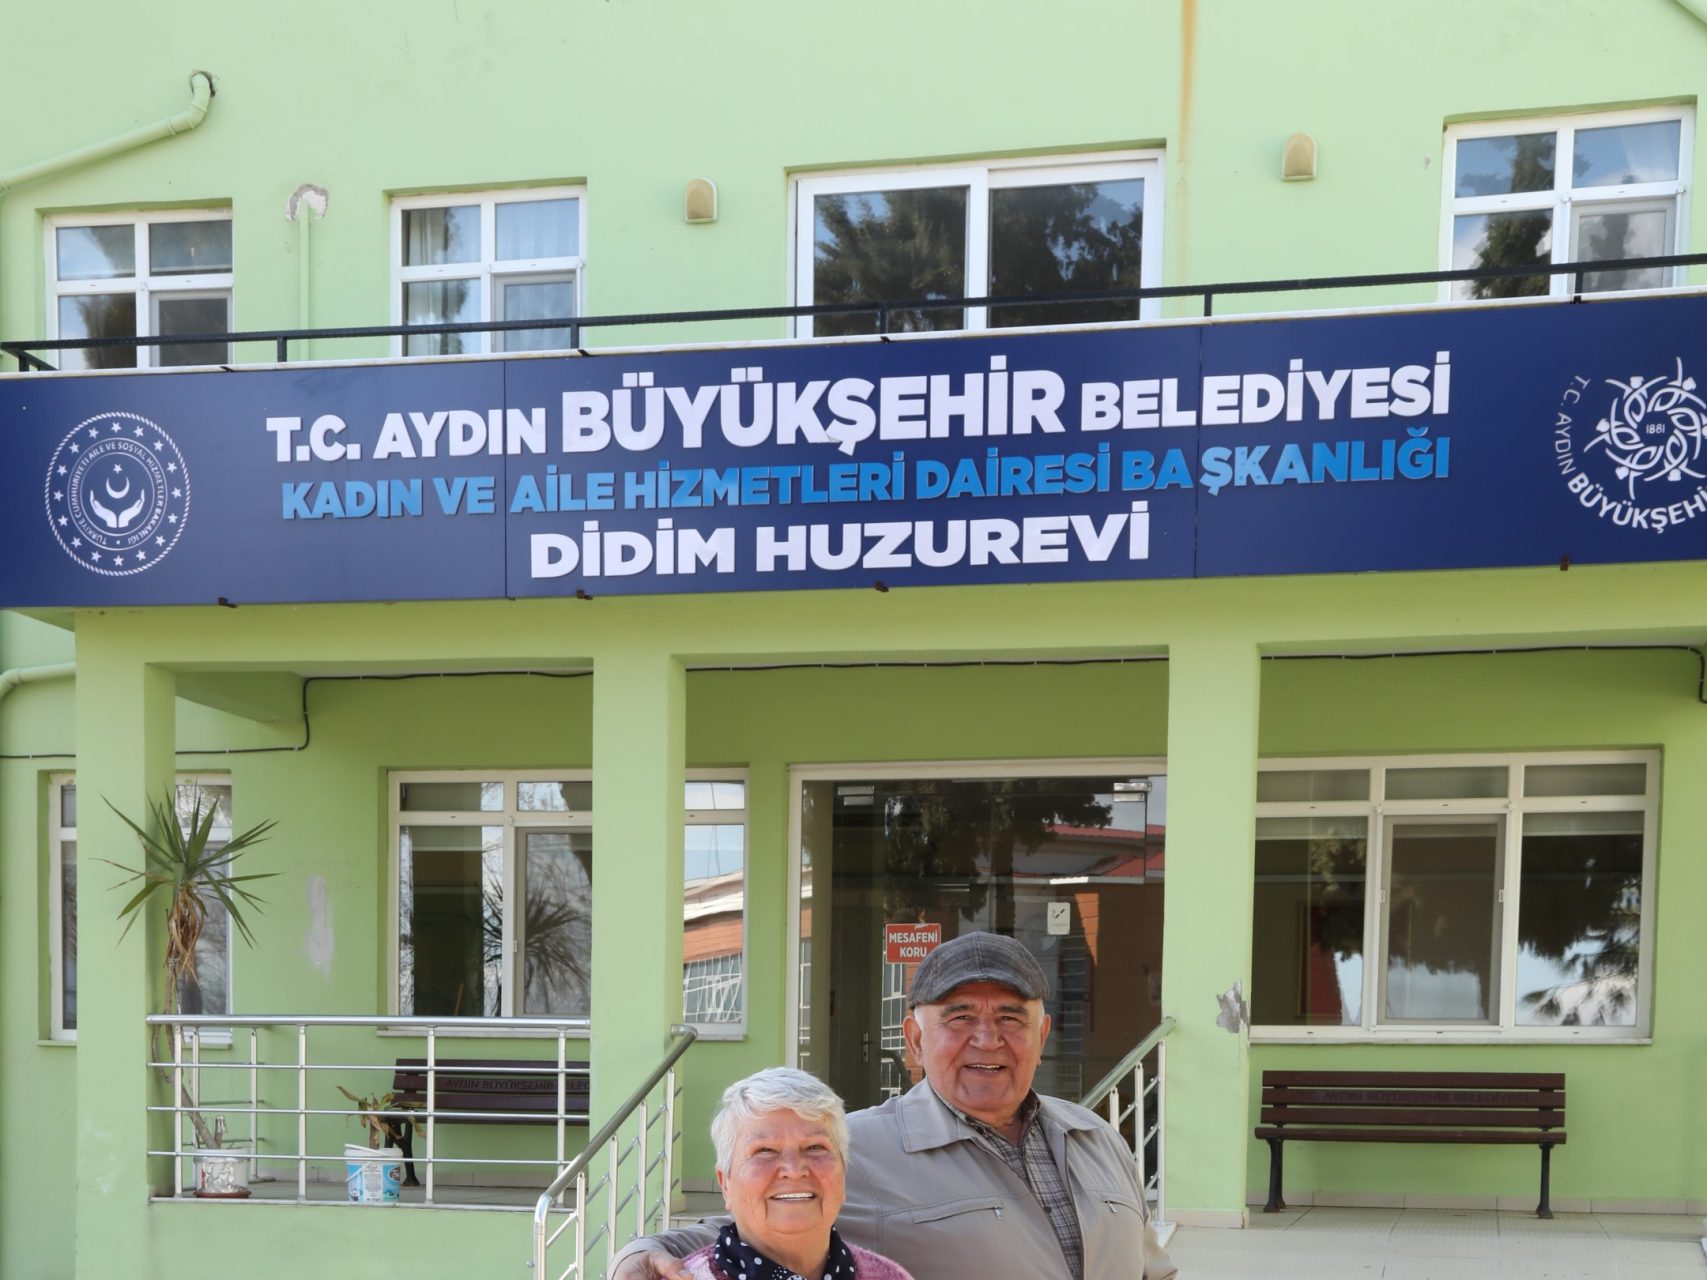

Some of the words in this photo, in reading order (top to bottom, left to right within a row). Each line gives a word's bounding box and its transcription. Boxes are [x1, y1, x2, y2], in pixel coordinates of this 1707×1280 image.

[1561, 375, 1591, 406] T.C.
[266, 414, 361, 462] T.C.
[373, 408, 546, 459] AYDIN
[562, 355, 1065, 456] BÜYÜKŞEHİR
[1081, 351, 1451, 431] BELEDİYESİ
[1555, 412, 1576, 475] AYDIN
[1646, 423, 1666, 434] 1881
[105, 442, 117, 451] VE
[118, 441, 146, 460] SOSYAL
[280, 477, 423, 520] KADIN
[432, 475, 495, 516] VE
[508, 463, 615, 513] AİLE
[623, 451, 905, 510] HİZMETLERİ
[916, 442, 1111, 499] DAİRESİ
[1567, 472, 1707, 534] BÜYÜKŞEHİ
[530, 518, 735, 578] DİDİM
[756, 500, 1150, 572] HUZUREVİ
[889, 930, 938, 943] MESAFENİ
[900, 947, 927, 957] KORU
[446, 1079, 480, 1089] AYDIN
